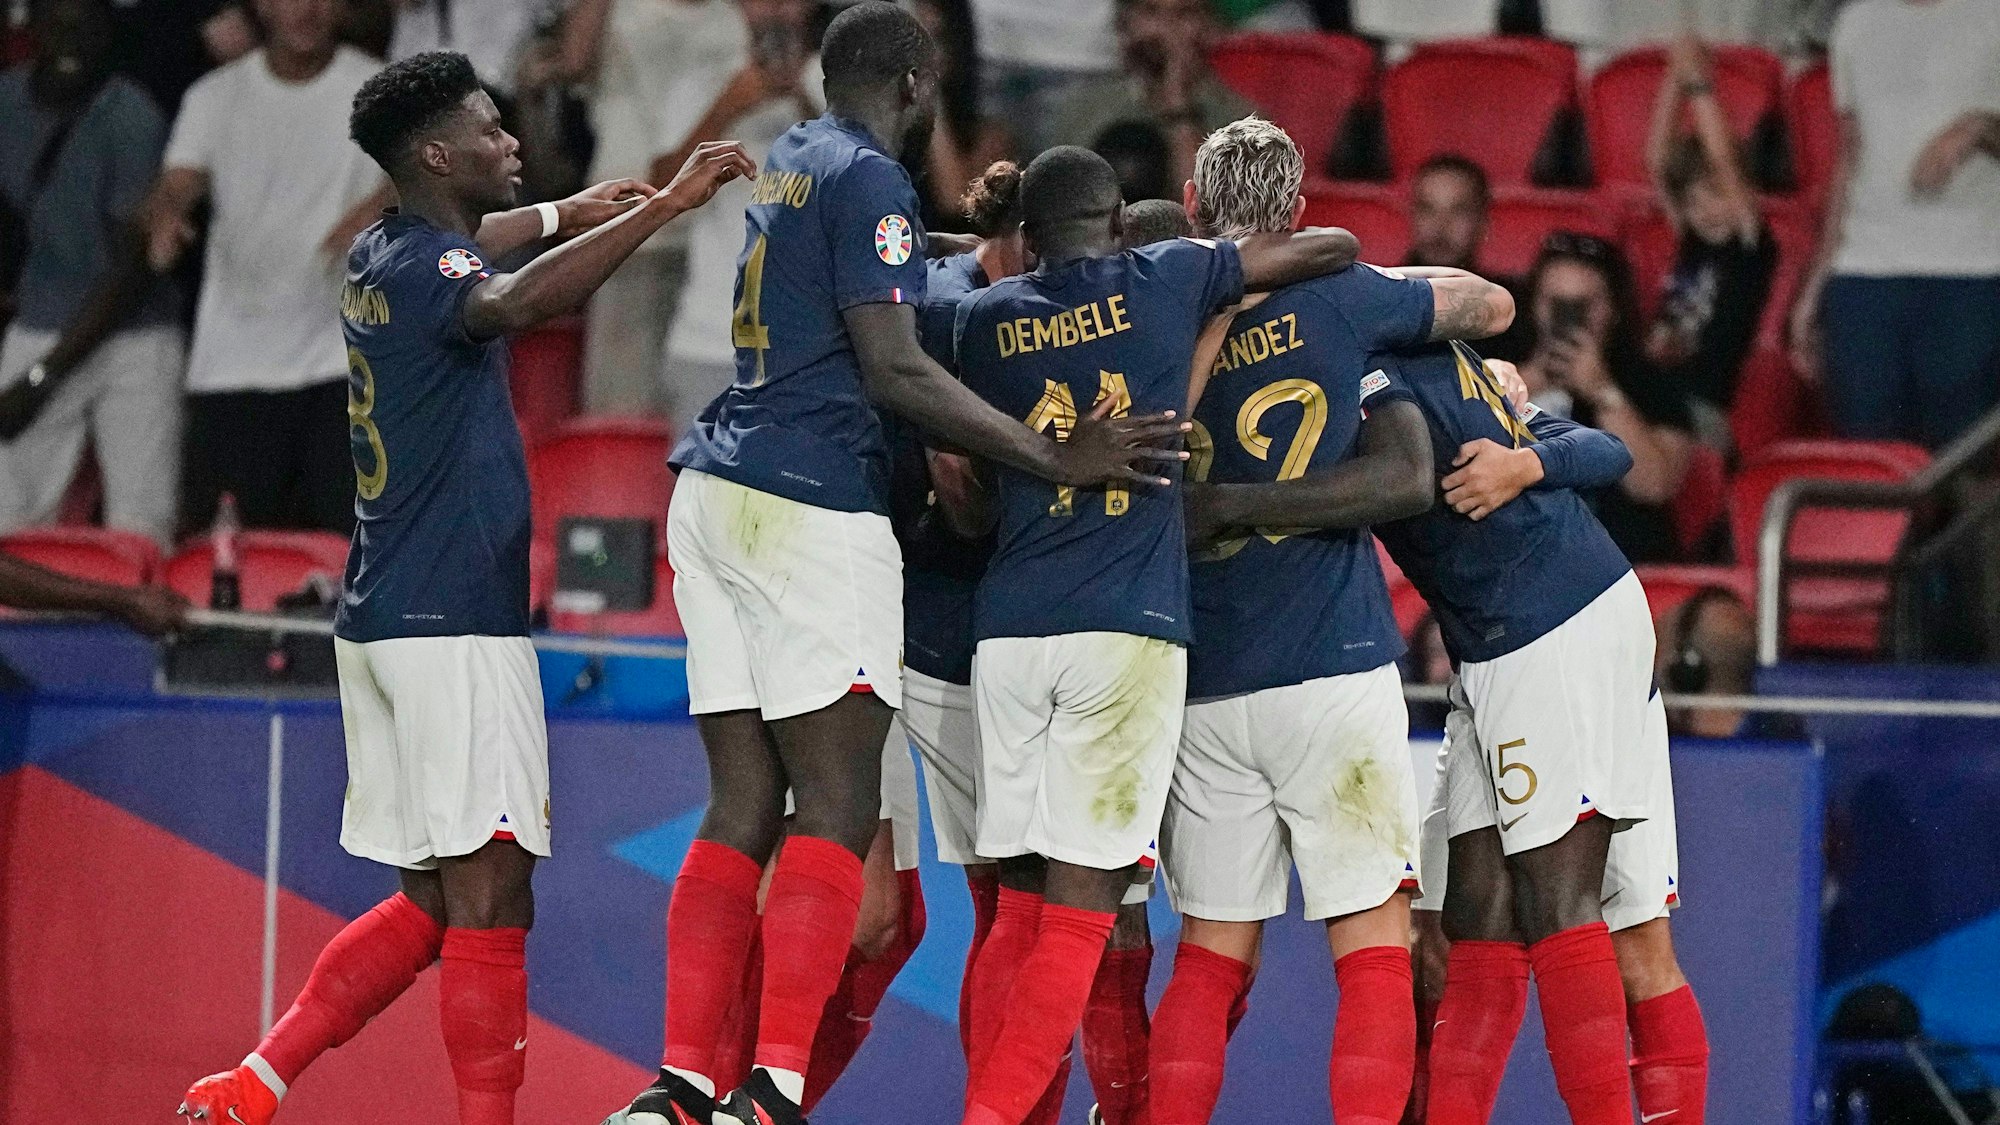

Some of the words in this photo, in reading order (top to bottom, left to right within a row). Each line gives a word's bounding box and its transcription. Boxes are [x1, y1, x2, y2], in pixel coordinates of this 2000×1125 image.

[732, 232, 771, 388] 4
[996, 294, 1132, 358] DEMBELE
[347, 346, 388, 501] 8
[1023, 369, 1133, 518] 11
[1487, 737, 1538, 812] 15
